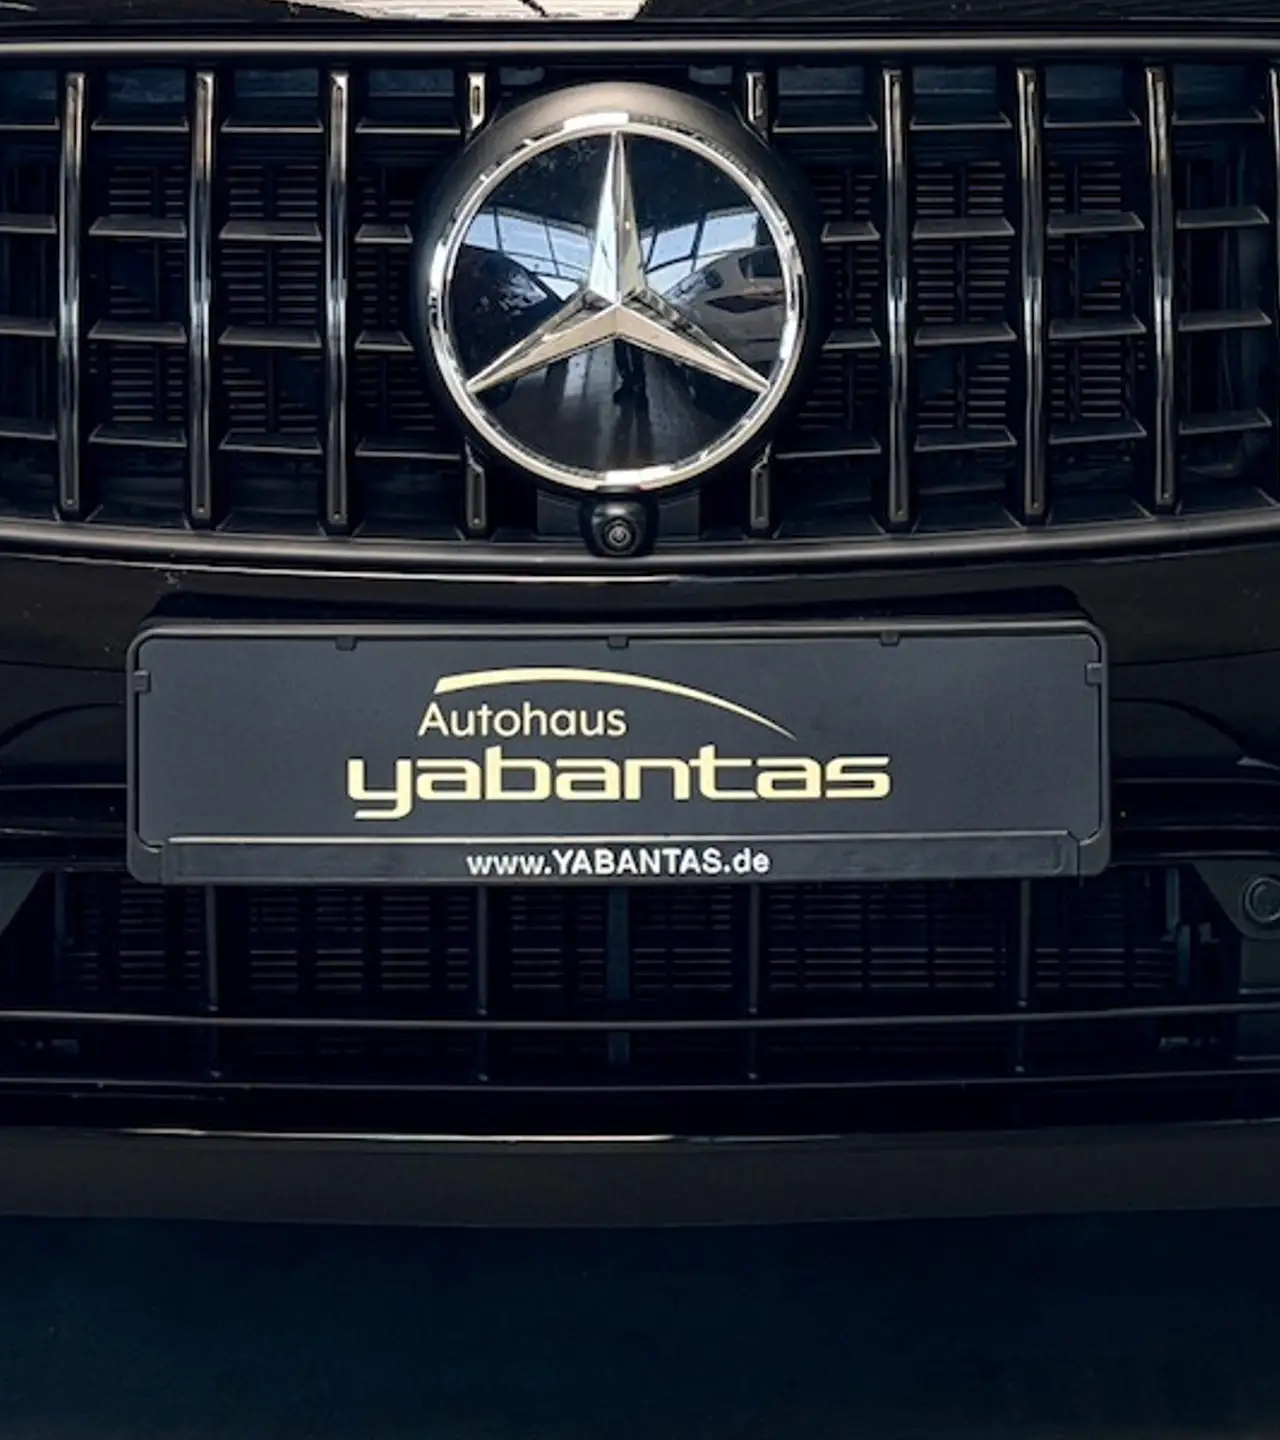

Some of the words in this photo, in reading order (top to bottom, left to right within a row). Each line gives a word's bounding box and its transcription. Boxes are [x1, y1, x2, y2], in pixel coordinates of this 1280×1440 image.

[417, 702, 627, 737] Autohaus
[348, 745, 891, 819] yabantas
[467, 848, 770, 875] www.YABANTAS.de
